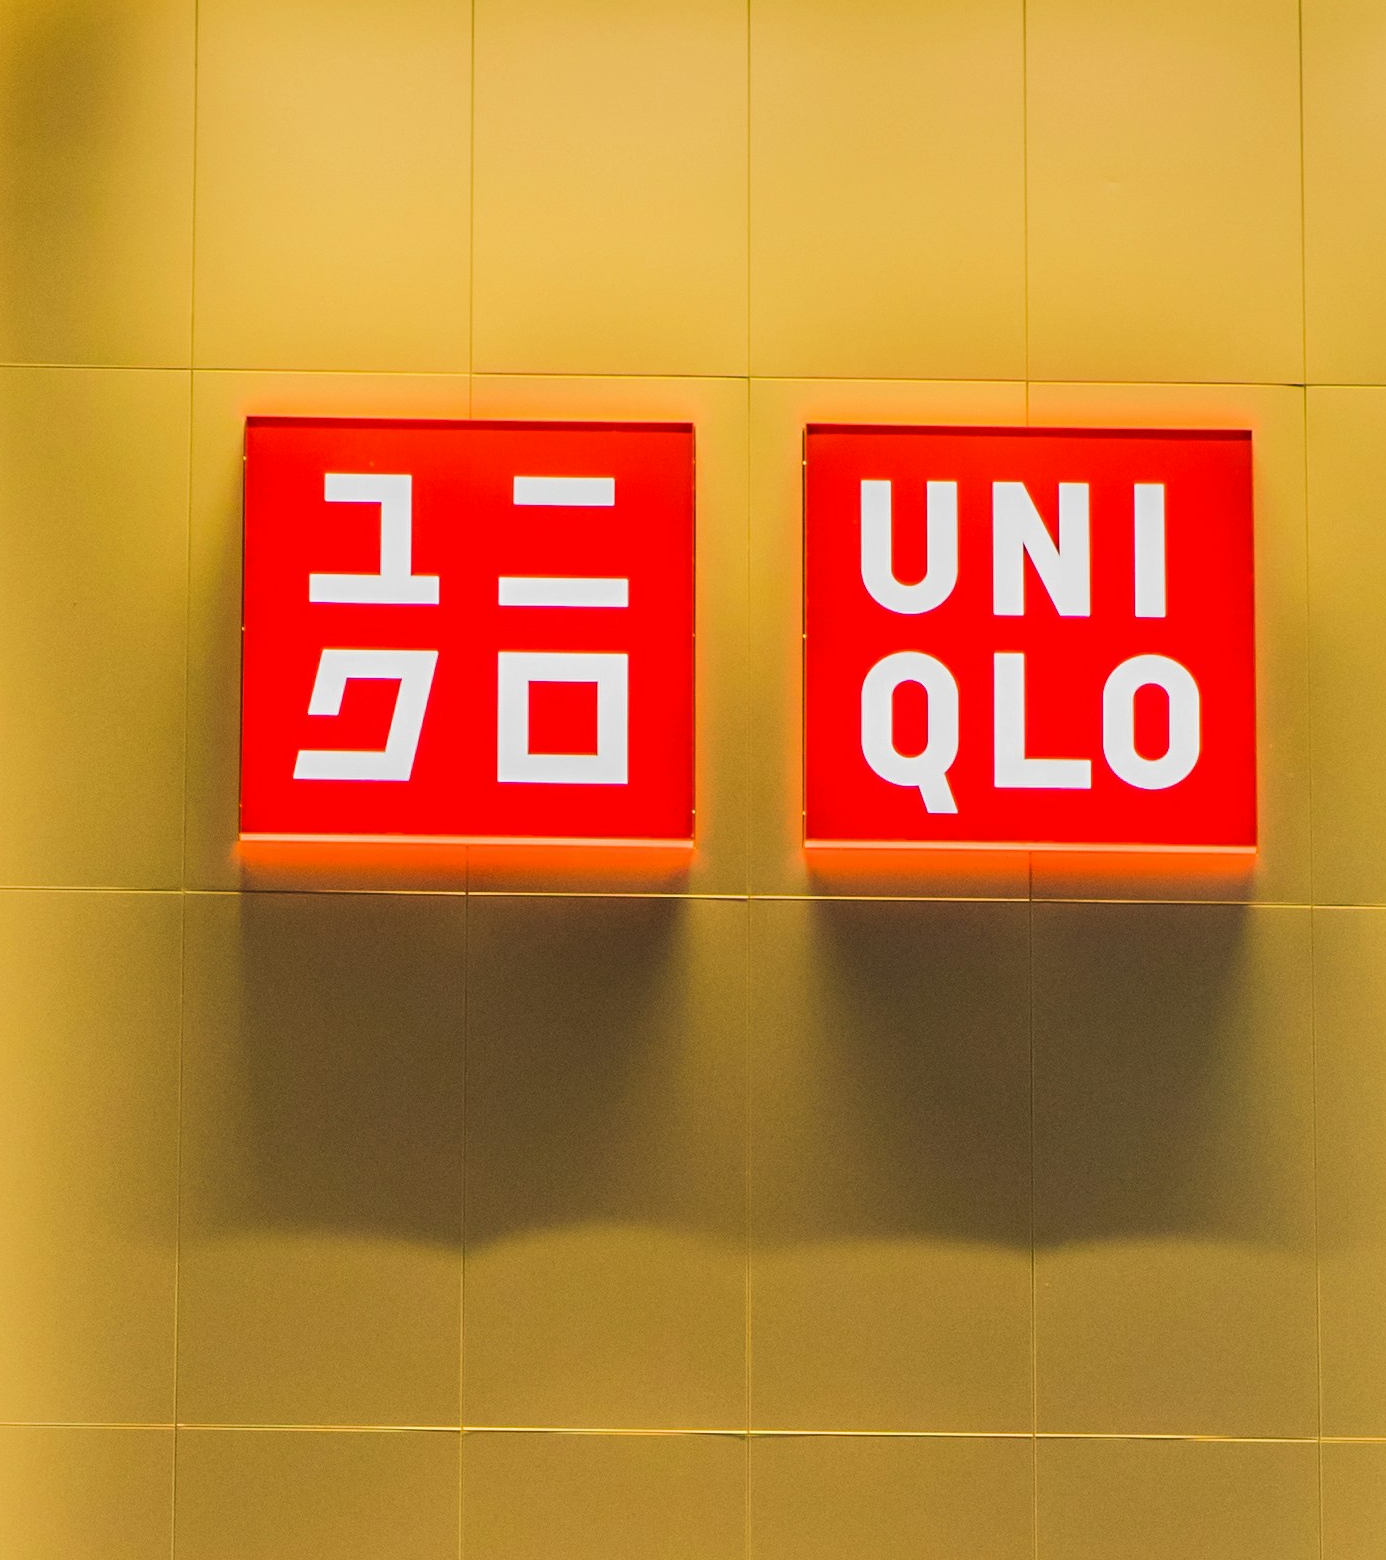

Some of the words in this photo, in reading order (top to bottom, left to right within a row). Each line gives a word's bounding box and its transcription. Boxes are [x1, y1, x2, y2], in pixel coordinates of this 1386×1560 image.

[308, 473, 629, 608] ユニ
[860, 480, 1167, 618] UNI
[293, 649, 629, 784] クロ
[860, 651, 1201, 814] QLO
